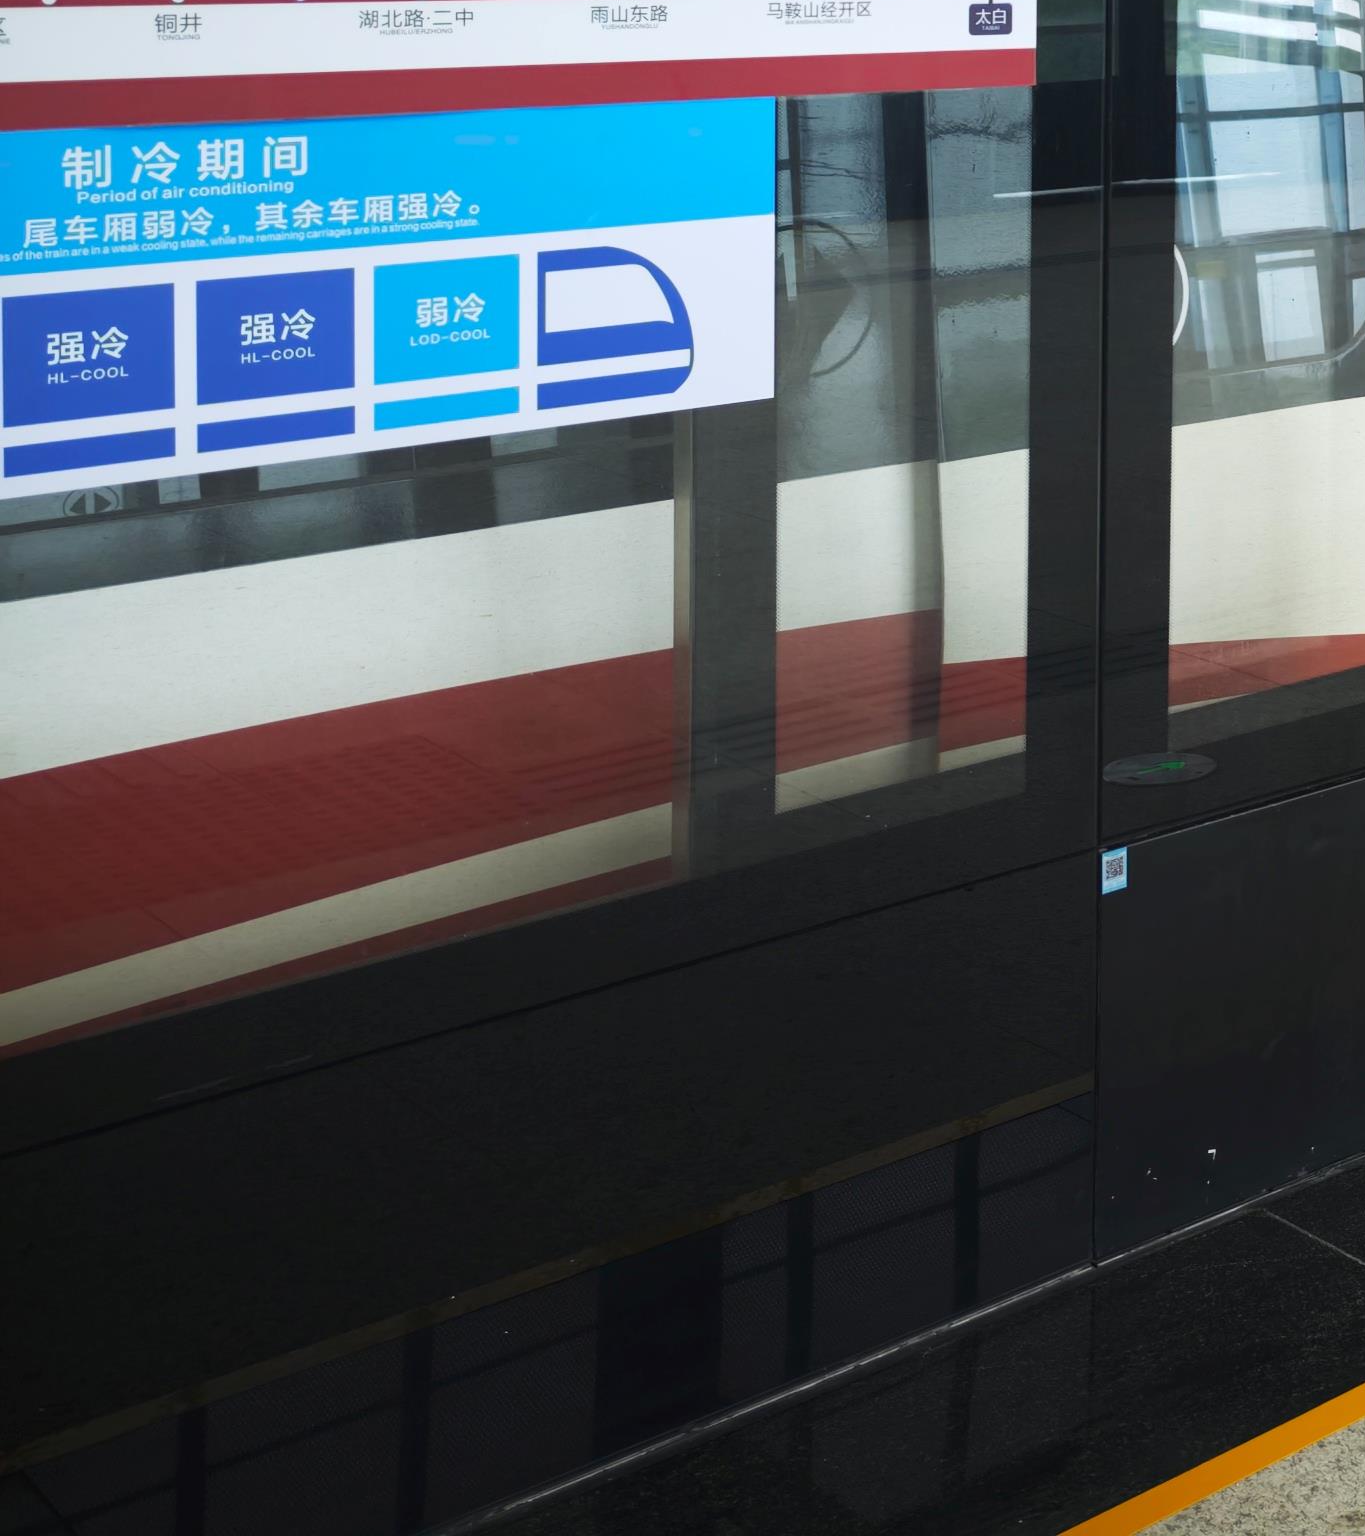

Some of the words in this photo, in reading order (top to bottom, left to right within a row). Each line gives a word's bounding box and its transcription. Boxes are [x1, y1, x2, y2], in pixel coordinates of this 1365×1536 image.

[359, 8, 474, 29] 湖北路·二中
[591, 5, 668, 24] 雨山东路
[766, 1, 872, 20] 马鞍山经开区
[975, 8, 1007, 25] 太白
[155, 13, 202, 34] 铜井
[61, 136, 308, 190] 制冷期间
[77, 187, 136, 204] Period
[141, 185, 158, 201] of
[162, 185, 185, 199] air
[189, 180, 294, 198] conditioning
[12, 250, 25, 261] of
[25, 250, 43, 260] the
[44, 247, 70, 259] train
[71, 247, 89, 256] are
[91, 245, 101, 255] in
[111, 242, 140, 254] weak
[141, 239, 179, 252] cooling
[211, 235, 237, 246] while
[238, 234, 254, 244] the
[256, 230, 305, 242] remaining
[306, 226, 352, 239] carriages
[354, 226, 370, 234] are
[371, 224, 380, 233] in
[389, 222, 419, 233] strong
[420, 219, 454, 231] cooling
[415, 292, 486, 328] 弱冷
[240, 308, 316, 346] 强冷
[47, 326, 129, 365] 强冷
[410, 329, 491, 347] LOD-COOL
[241, 347, 316, 364] HL-COOL
[47, 365, 129, 385] HL-COOL
